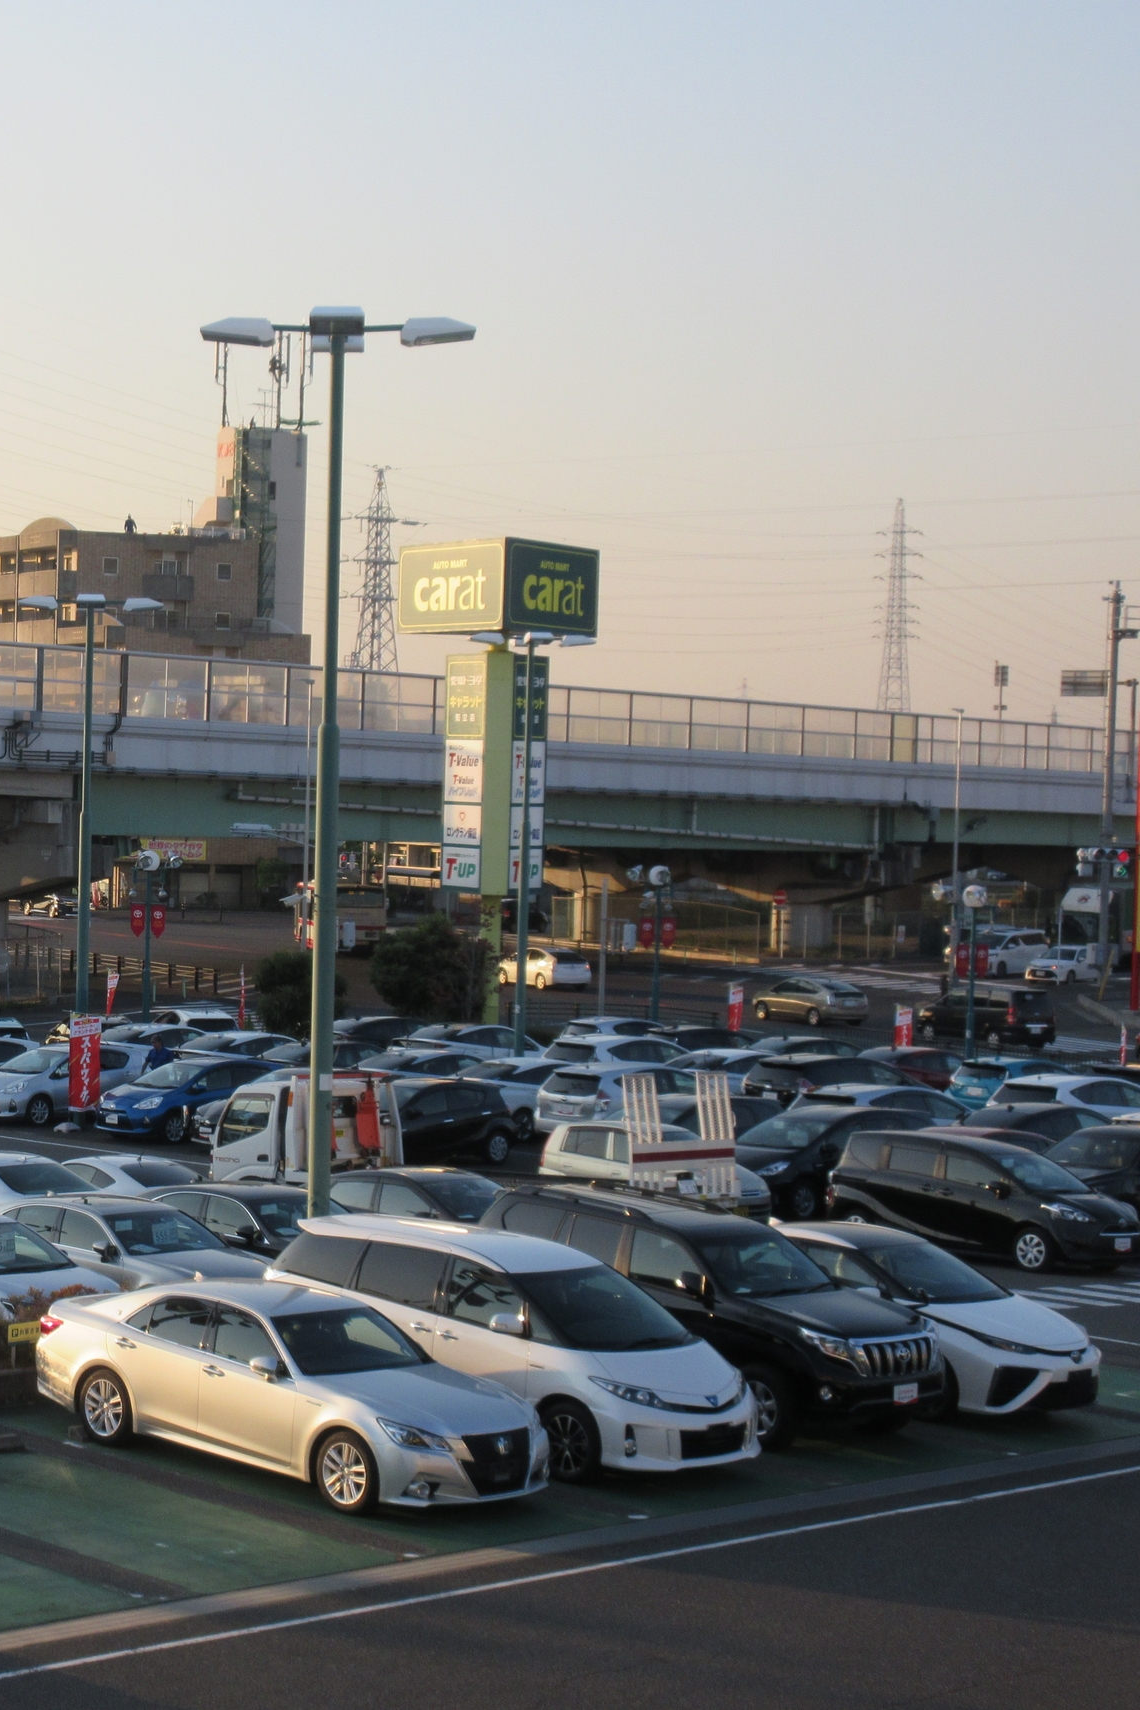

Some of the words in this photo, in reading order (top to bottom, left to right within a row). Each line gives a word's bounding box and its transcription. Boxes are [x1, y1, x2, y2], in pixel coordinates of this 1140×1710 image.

[433, 560, 449, 570] AUTO
[450, 559, 468, 569] MART
[539, 560, 554, 569] AUTO
[555, 562, 570, 572] MART
[414, 568, 486, 612] carat
[523, 574, 585, 617] carat
[450, 695, 482, 708] キャラット
[446, 827, 477, 839] ロングラン保証
